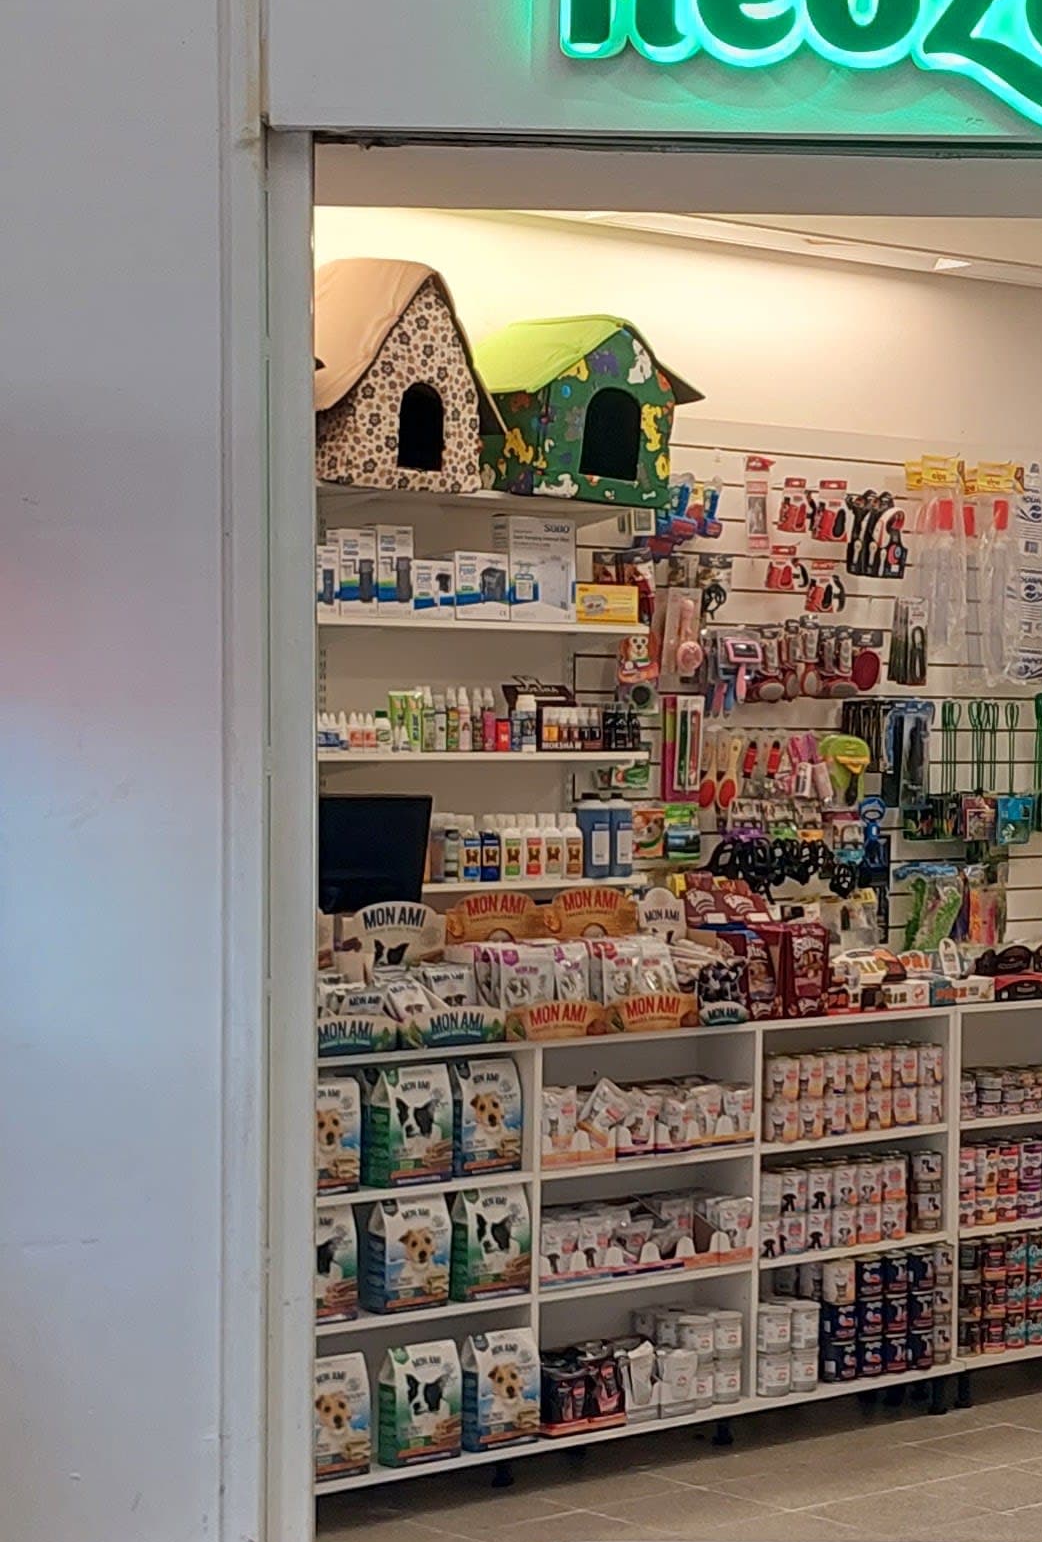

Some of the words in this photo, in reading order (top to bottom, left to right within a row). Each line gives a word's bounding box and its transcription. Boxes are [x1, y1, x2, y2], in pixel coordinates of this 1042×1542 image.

[466, 895, 498, 916] MON
[500, 894, 528, 914] AMI
[563, 891, 594, 911] MON
[594, 890, 619, 910] AMI
[363, 907, 396, 930] MON
[398, 906, 426, 927] AMI
[644, 909, 662, 922] MON
[663, 909, 680, 921] AMI
[529, 1007, 560, 1027] MON
[560, 1005, 588, 1023] AMI
[625, 998, 655, 1019] MON
[656, 996, 681, 1015] AMI
[318, 1021, 347, 1042] MON
[348, 1020, 374, 1038] AMI
[430, 1013, 456, 1034] MON
[457, 1011, 484, 1030] AMI
